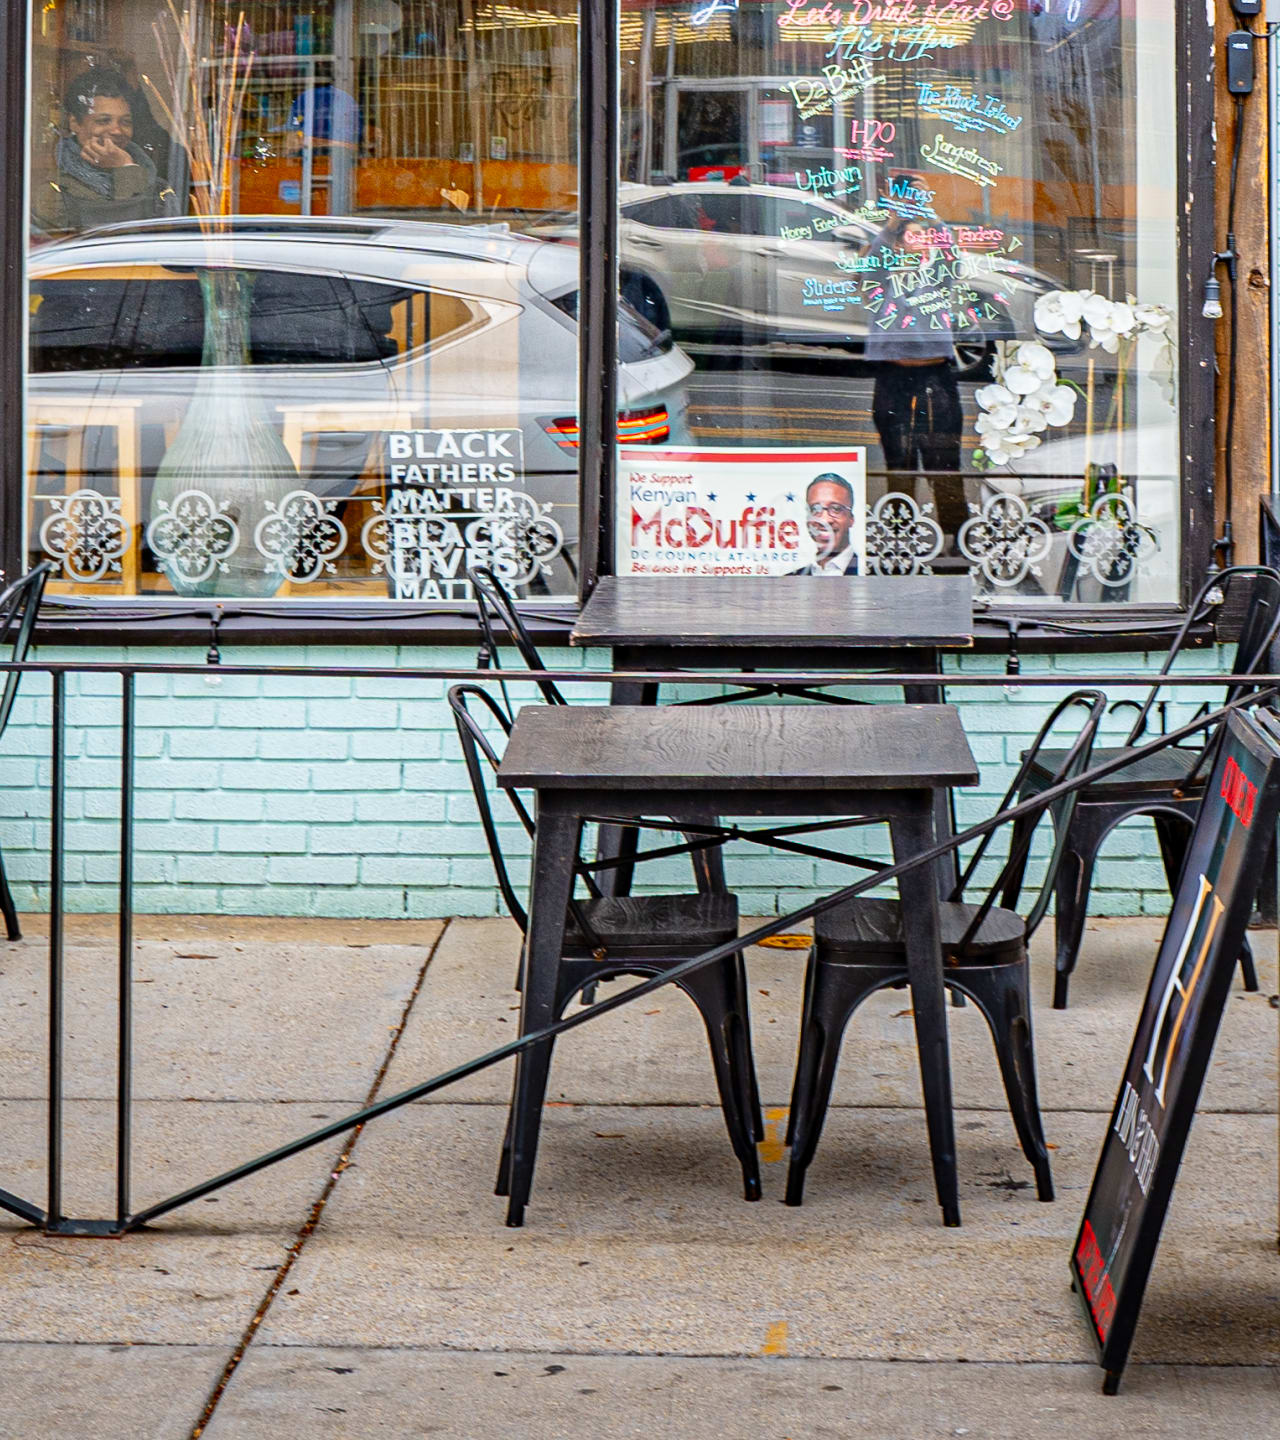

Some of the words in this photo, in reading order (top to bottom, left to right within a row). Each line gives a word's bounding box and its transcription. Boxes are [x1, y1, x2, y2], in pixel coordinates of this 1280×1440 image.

[795, 165, 864, 200] Uptown
[887, 177, 937, 206] Wings
[779, 224, 812, 241] Honey
[904, 227, 953, 244] Catfish
[953, 225, 1004, 243] Tenders
[886, 247, 1008, 299] KARAOKE
[802, 278, 859, 298] Sliders
[389, 432, 514, 459] BLACK
[391, 462, 516, 484] FATHERS
[650, 472, 694, 486] Support
[390, 487, 516, 510] MATTER
[630, 485, 697, 507] Kenyan
[394, 522, 516, 548] BLACK
[631, 505, 800, 550] McDuffie
[394, 547, 519, 579] LIVES
[655, 551, 722, 561] COUNCIL
[728, 552, 799, 561] AT-LARGE
[700, 563, 753, 577] Supports
